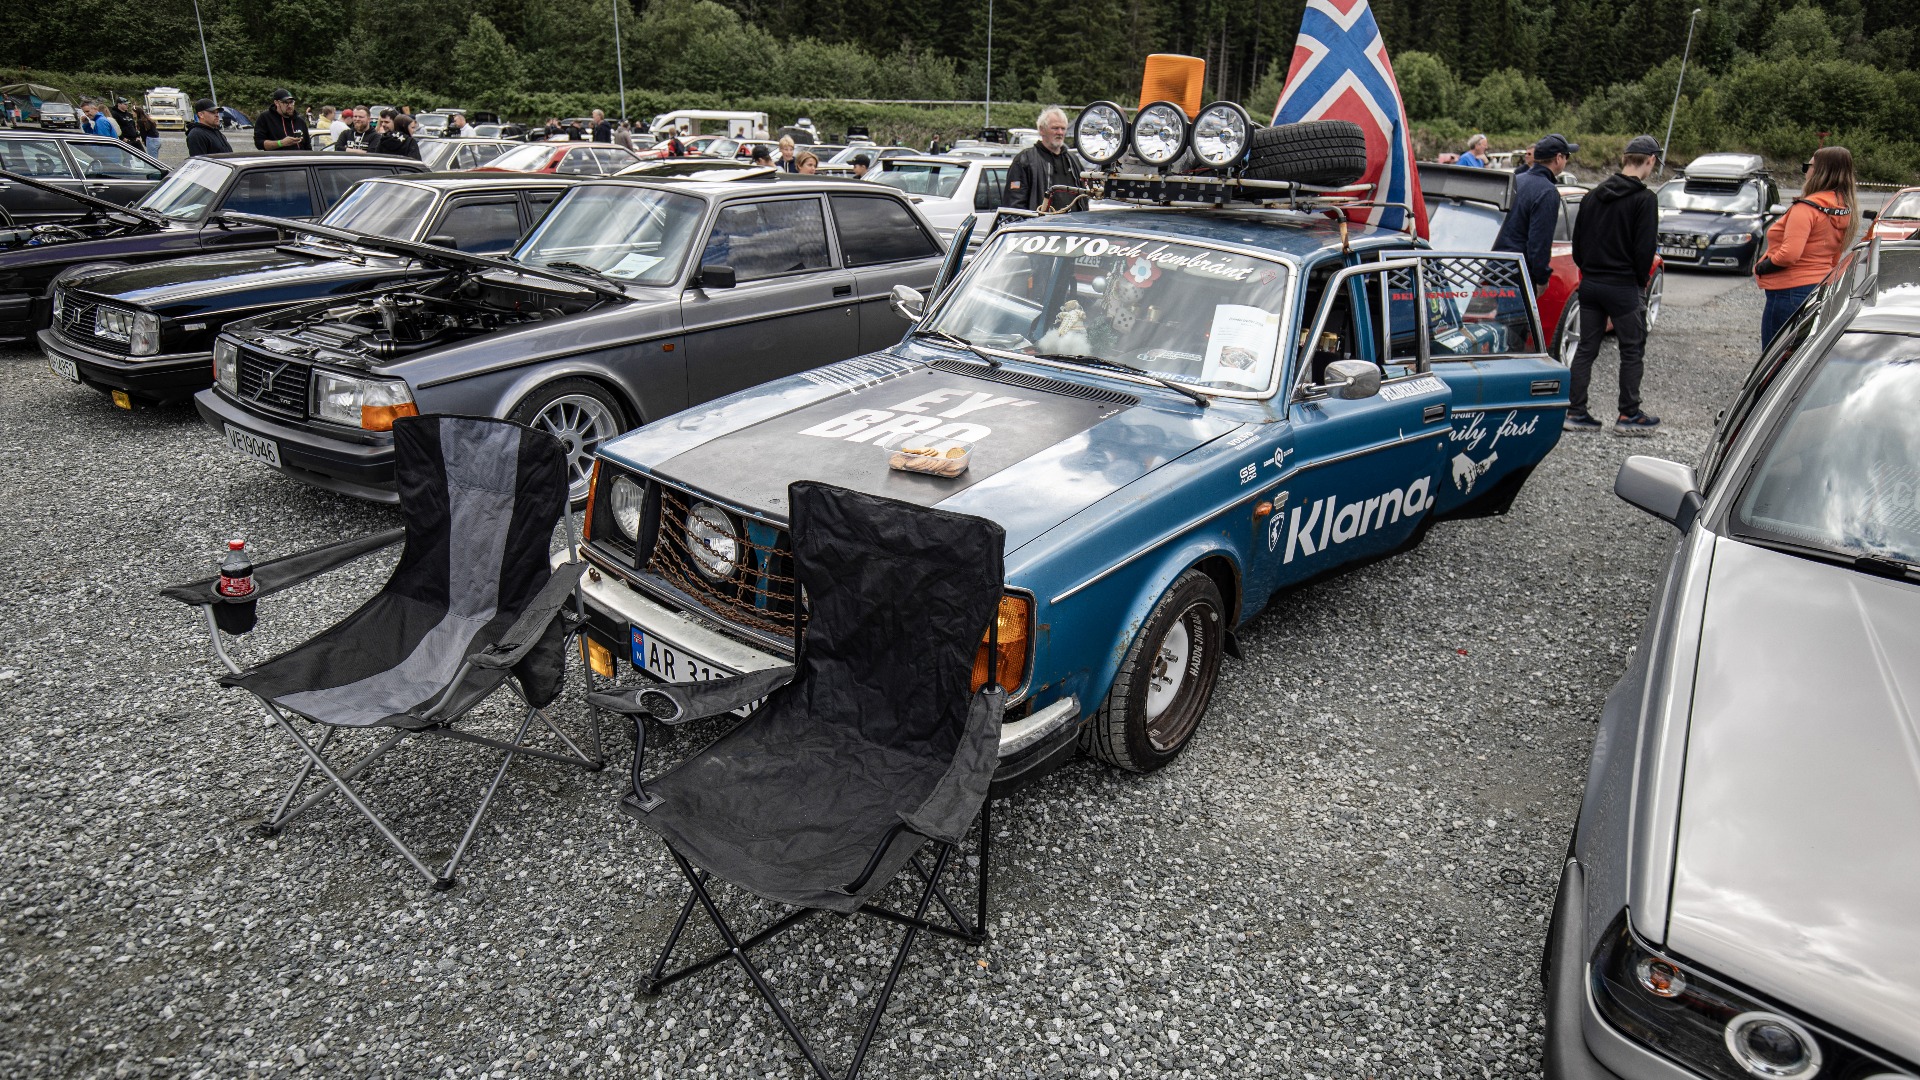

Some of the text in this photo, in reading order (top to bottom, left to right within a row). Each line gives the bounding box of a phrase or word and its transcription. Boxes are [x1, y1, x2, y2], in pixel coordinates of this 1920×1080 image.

[1006, 235, 1254, 281] VOLVO och hembränt
[1471, 288, 1516, 299] PÅGÅR
[797, 408, 991, 448] BRO
[1450, 411, 1476, 419] PPORT
[1489, 410, 1540, 449] first
[229, 429, 276, 463] VE19046
[1226, 431, 1254, 447] VOLVO
[1239, 462, 1256, 478] GS
[1283, 475, 1435, 564] Klarna.
[636, 651, 642, 661] N
[650, 642, 676, 681] AR
